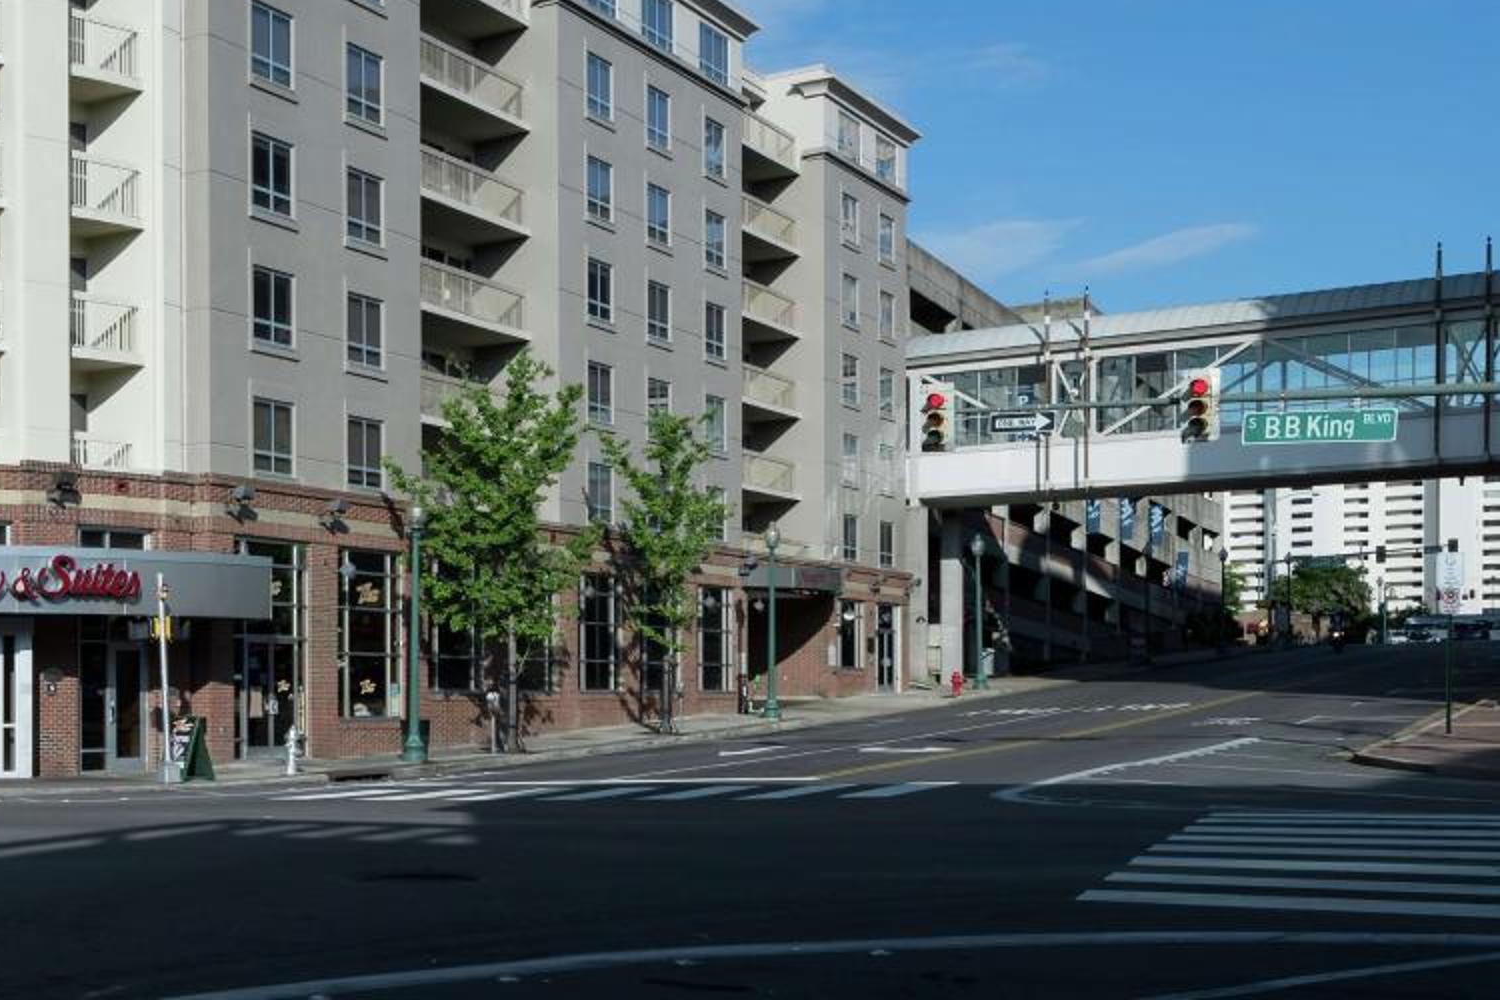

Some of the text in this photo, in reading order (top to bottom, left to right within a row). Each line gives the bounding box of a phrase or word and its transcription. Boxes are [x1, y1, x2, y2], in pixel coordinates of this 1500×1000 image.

[1249, 418, 1257, 429] S
[1307, 414, 1355, 439] King
[1363, 413, 1391, 424] BLVD
[11, 567, 39, 605] &
[37, 555, 142, 605] Suites
